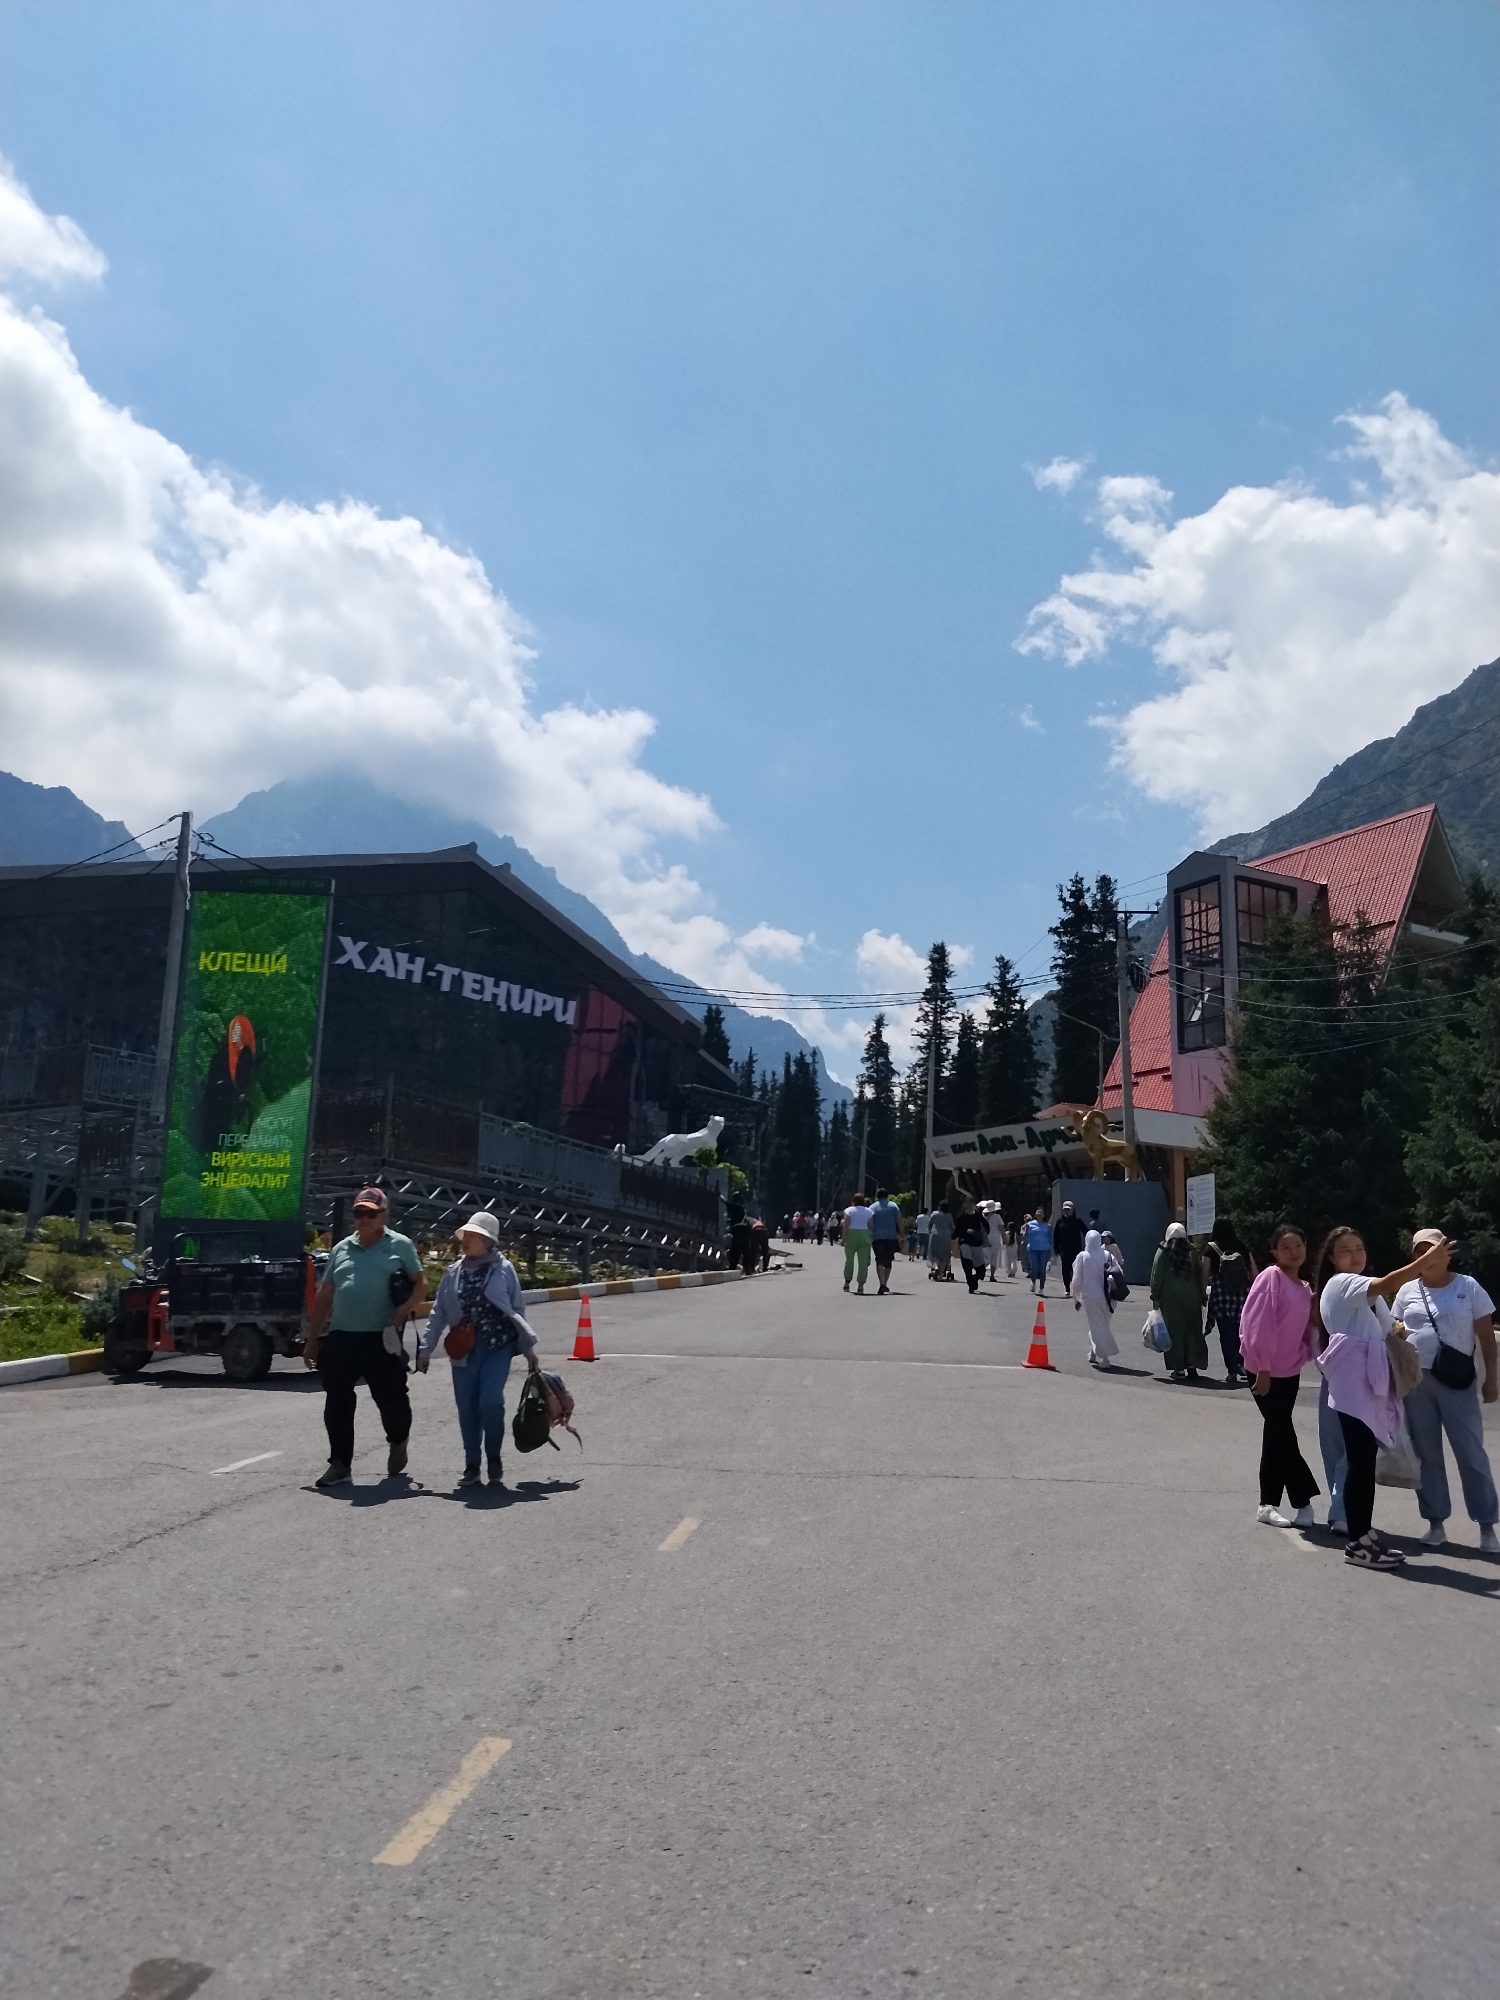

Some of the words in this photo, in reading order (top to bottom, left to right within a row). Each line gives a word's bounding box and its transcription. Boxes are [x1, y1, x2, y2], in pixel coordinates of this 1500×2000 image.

[199, 951, 288, 976] КЛЕЩИ
[211, 1149, 291, 1168] ВИРУСНЫЙ
[200, 1171, 291, 1190] ЭНЦЕФАЛИТ
